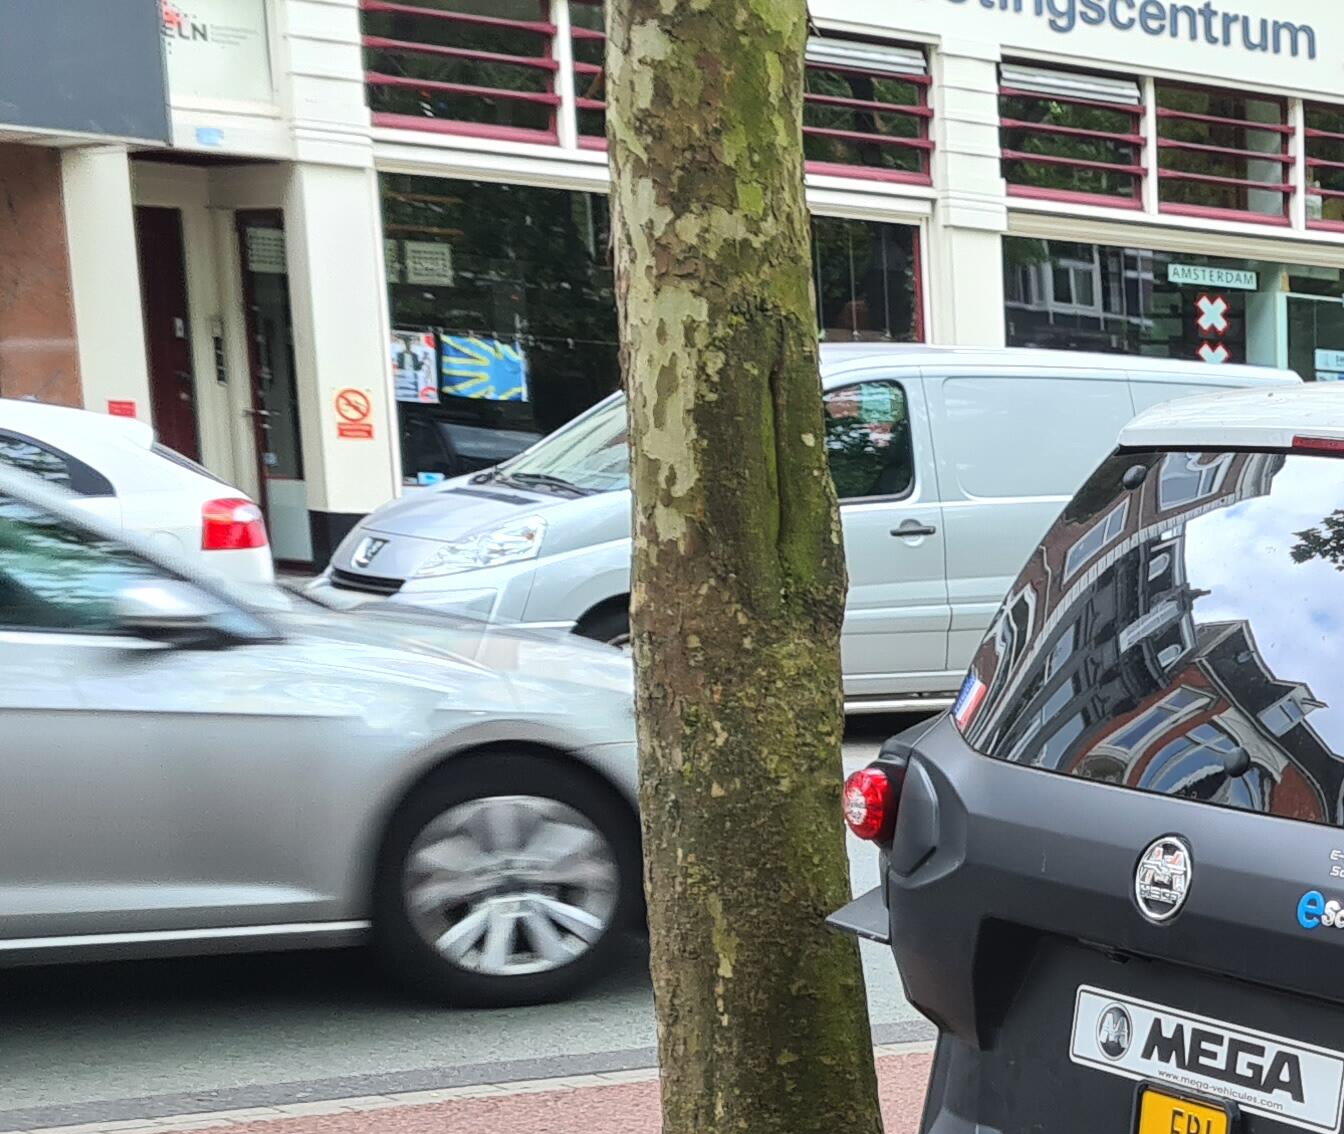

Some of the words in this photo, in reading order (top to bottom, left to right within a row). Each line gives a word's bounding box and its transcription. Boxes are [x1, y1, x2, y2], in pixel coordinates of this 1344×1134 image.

[947, 0, 1316, 60] gscentrum
[1172, 267, 1255, 285] AMSTERDAM
[1140, 1017, 1306, 1104] MEGA
[1157, 1069, 1284, 1112] www.mega-vehicules.com
